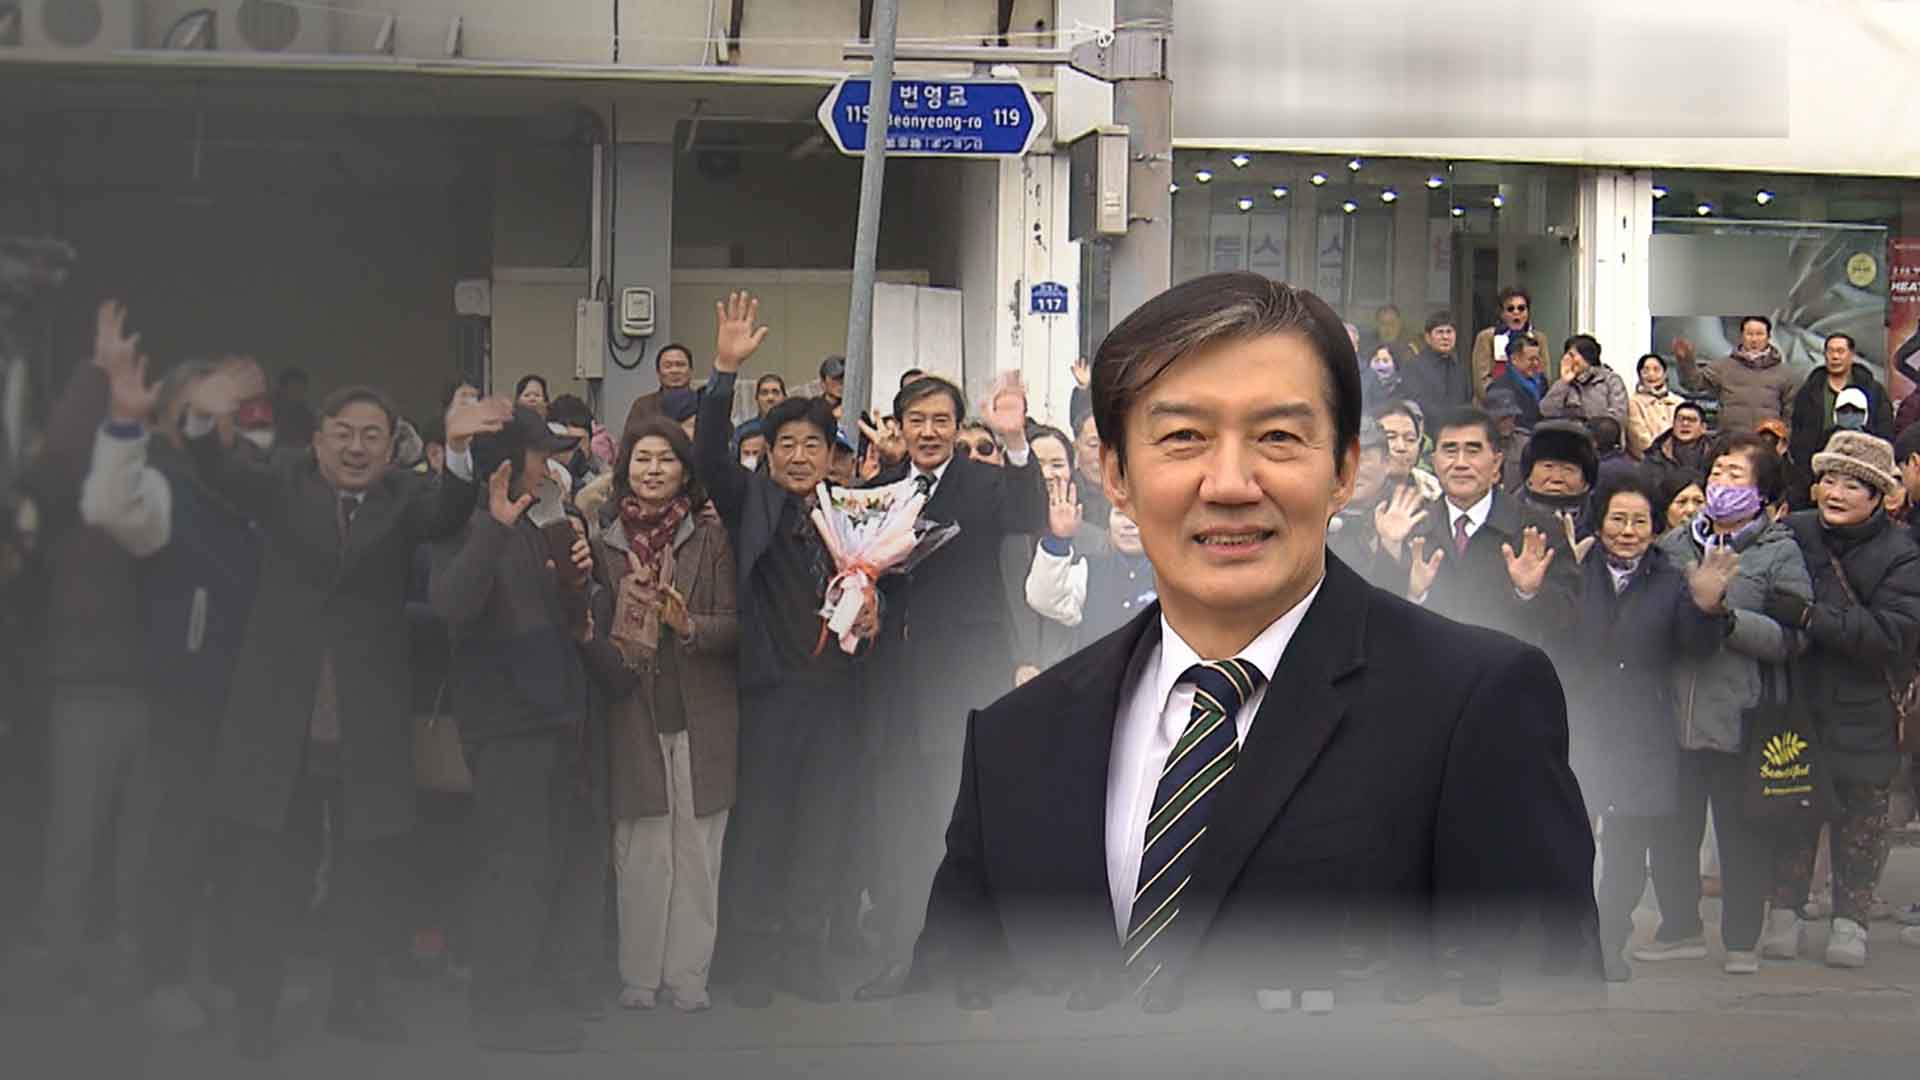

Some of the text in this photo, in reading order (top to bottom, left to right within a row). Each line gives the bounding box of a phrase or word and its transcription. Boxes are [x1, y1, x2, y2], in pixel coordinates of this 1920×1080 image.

[900, 86, 967, 109] 번영로
[993, 109, 1020, 126] 119
[1038, 298, 1061, 310] 117
